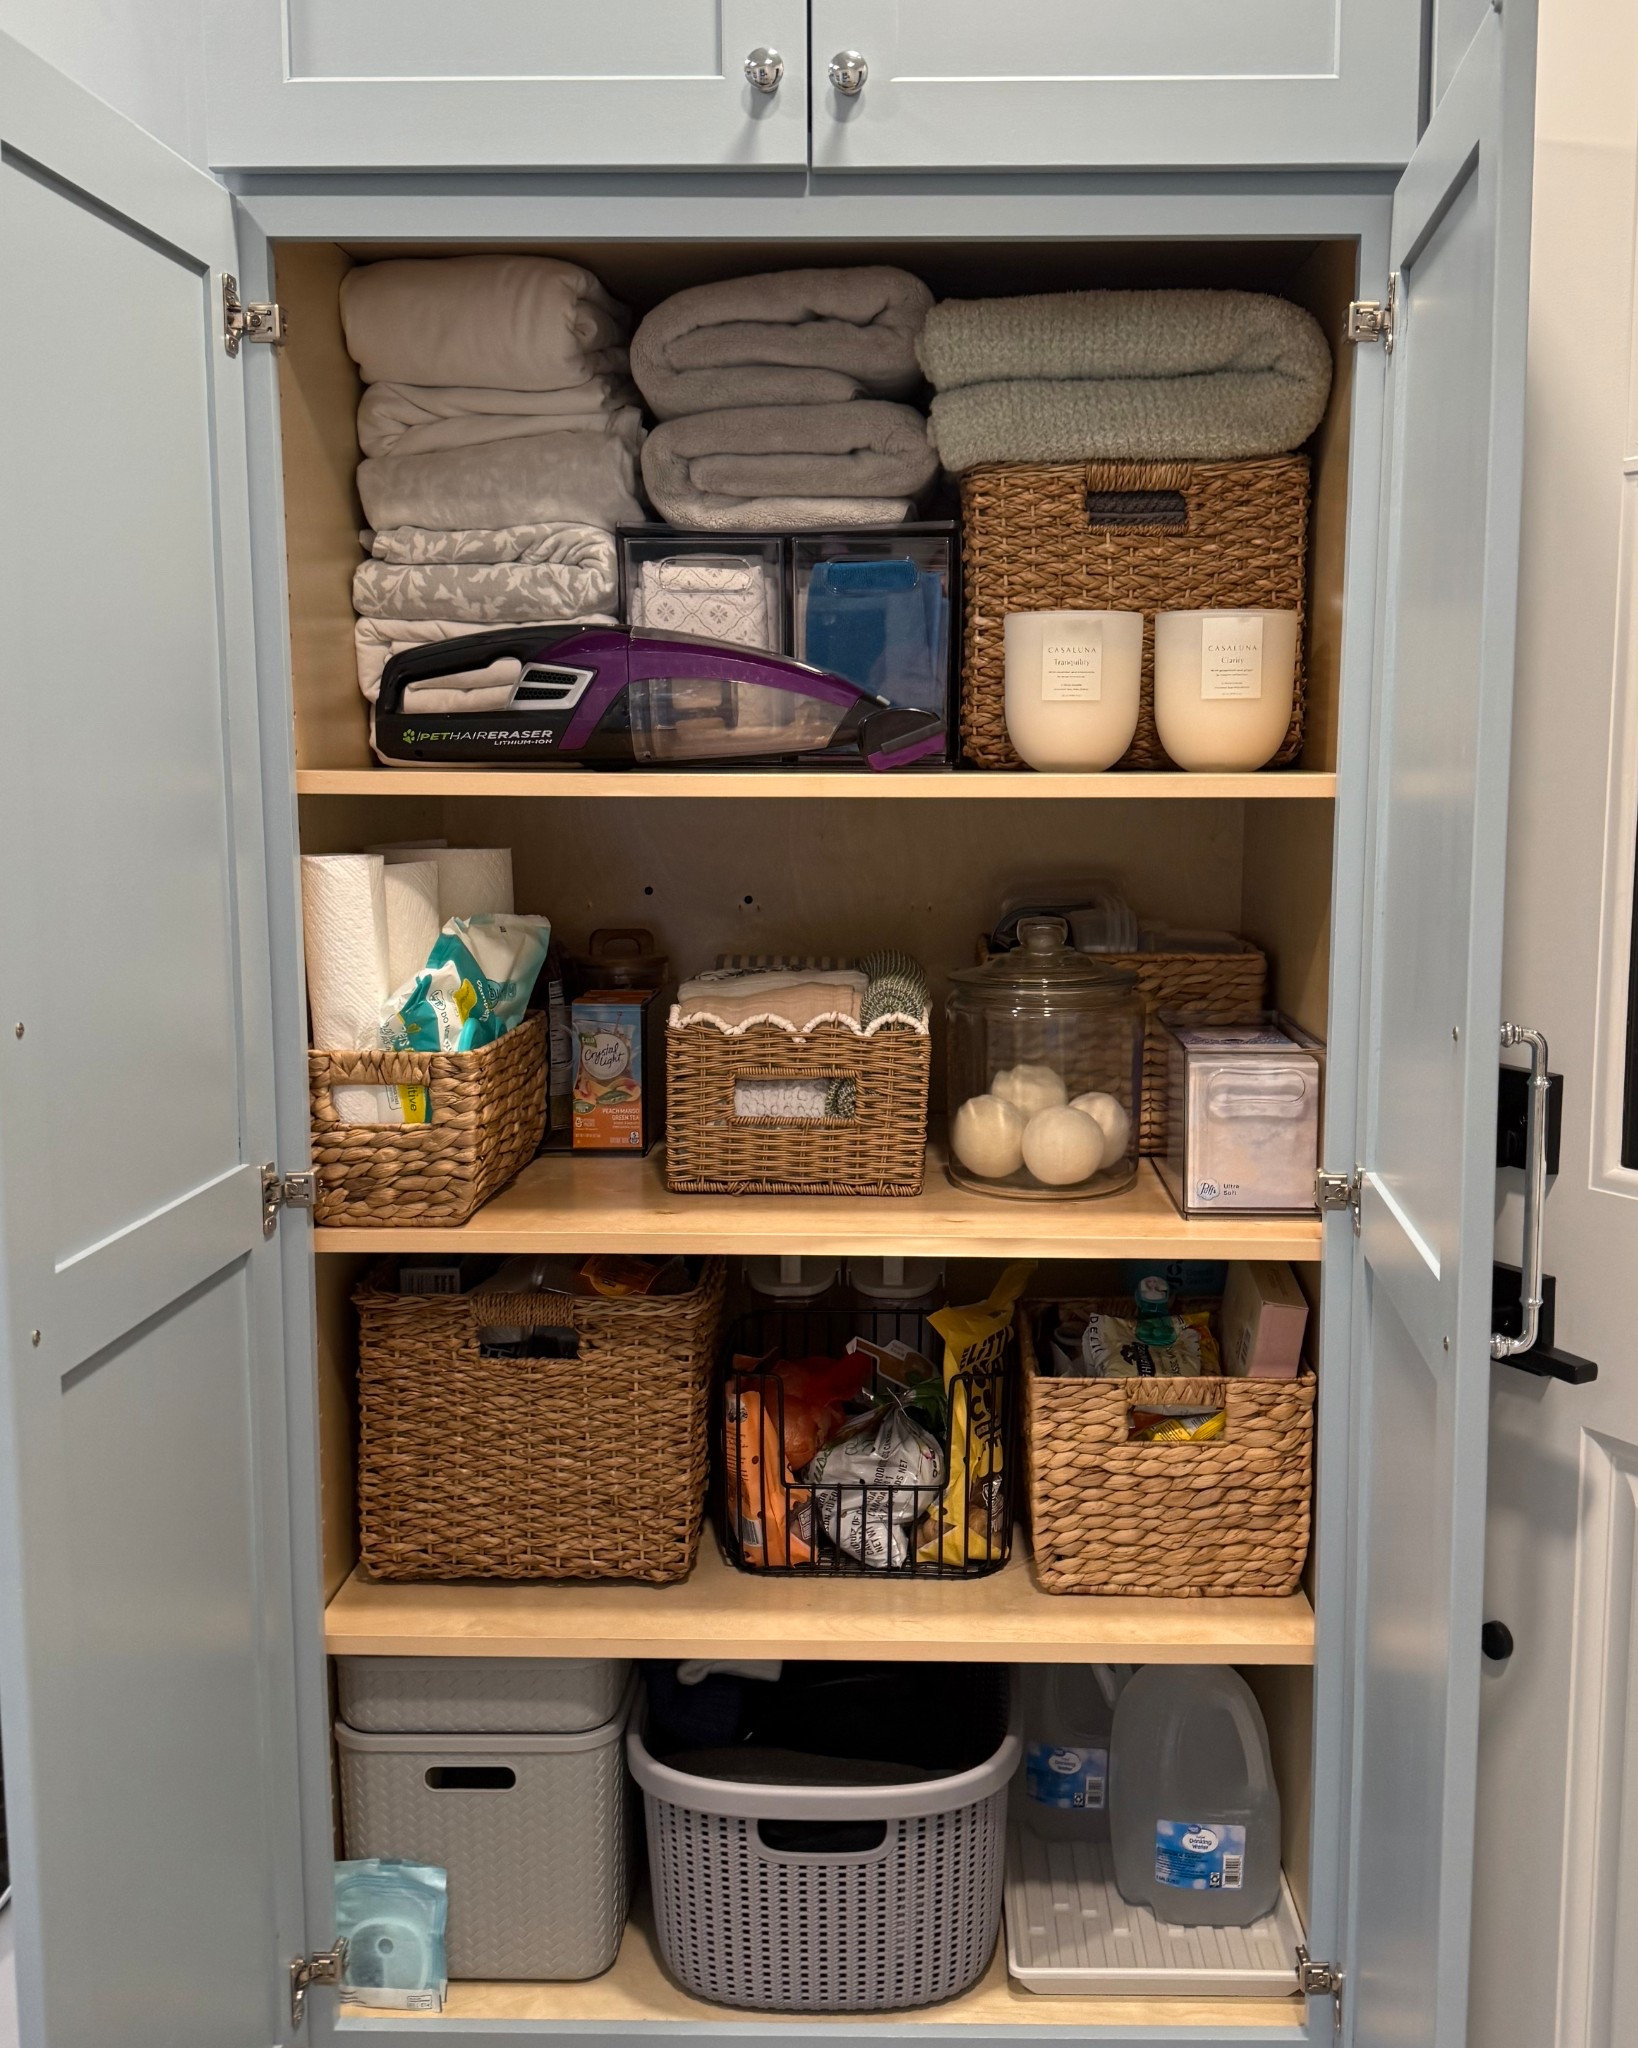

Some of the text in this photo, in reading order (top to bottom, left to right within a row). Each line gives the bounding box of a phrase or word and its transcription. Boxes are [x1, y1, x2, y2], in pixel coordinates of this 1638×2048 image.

[1221, 656, 1244, 664] Clarity
[584, 1042, 619, 1065] Crystal
[599, 1053, 625, 1068] Light
[407, 1084, 417, 1111] itive
[873, 1536, 884, 1553] NET
[1189, 1838, 1212, 1846] Drinking
